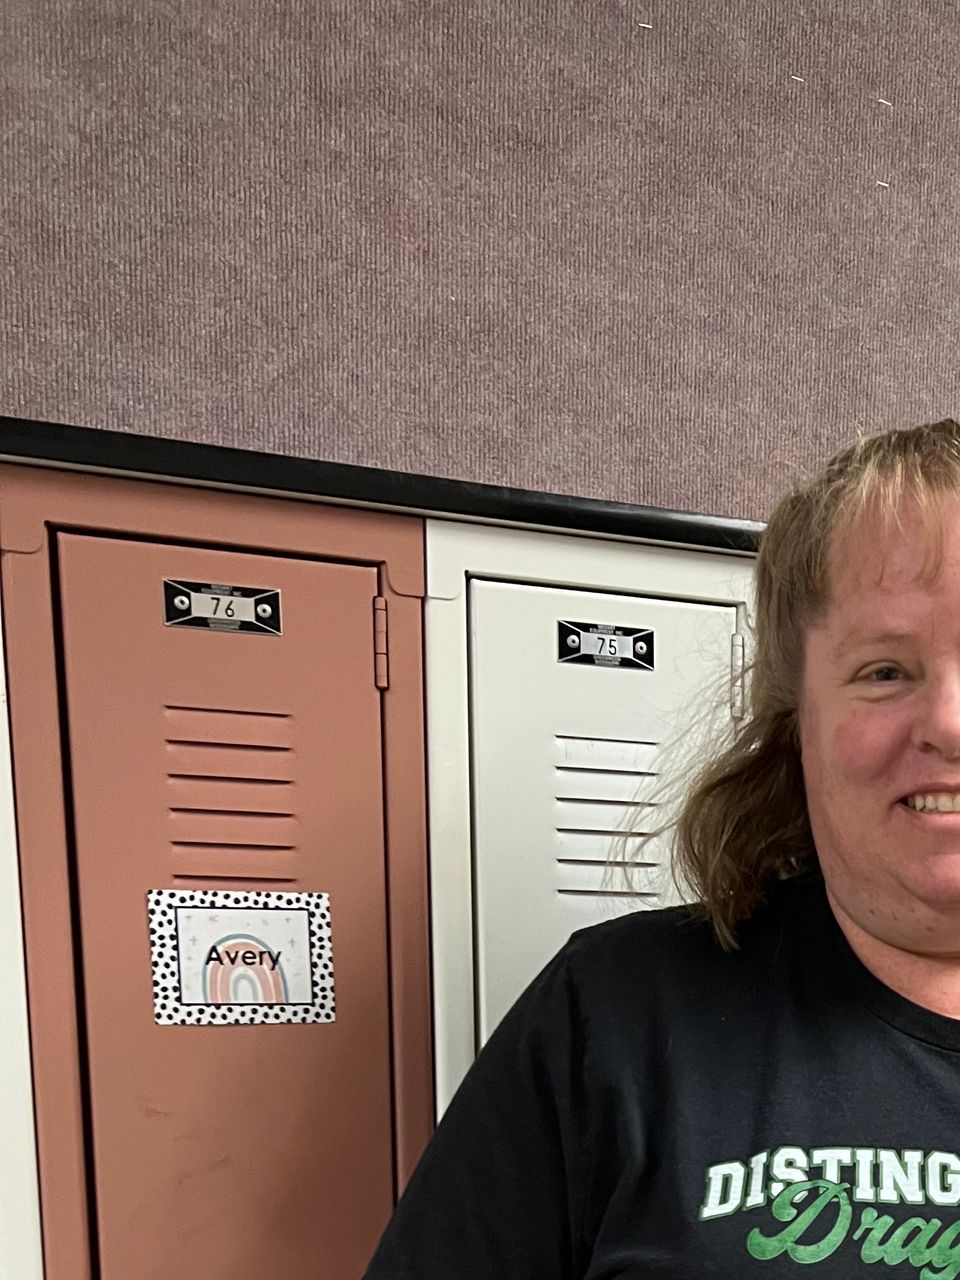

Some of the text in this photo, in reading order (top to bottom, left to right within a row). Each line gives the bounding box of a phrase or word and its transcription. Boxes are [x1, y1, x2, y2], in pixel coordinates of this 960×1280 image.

[210, 596, 235, 618] 76
[597, 636, 617, 656] 75
[205, 945, 282, 971] Avery
